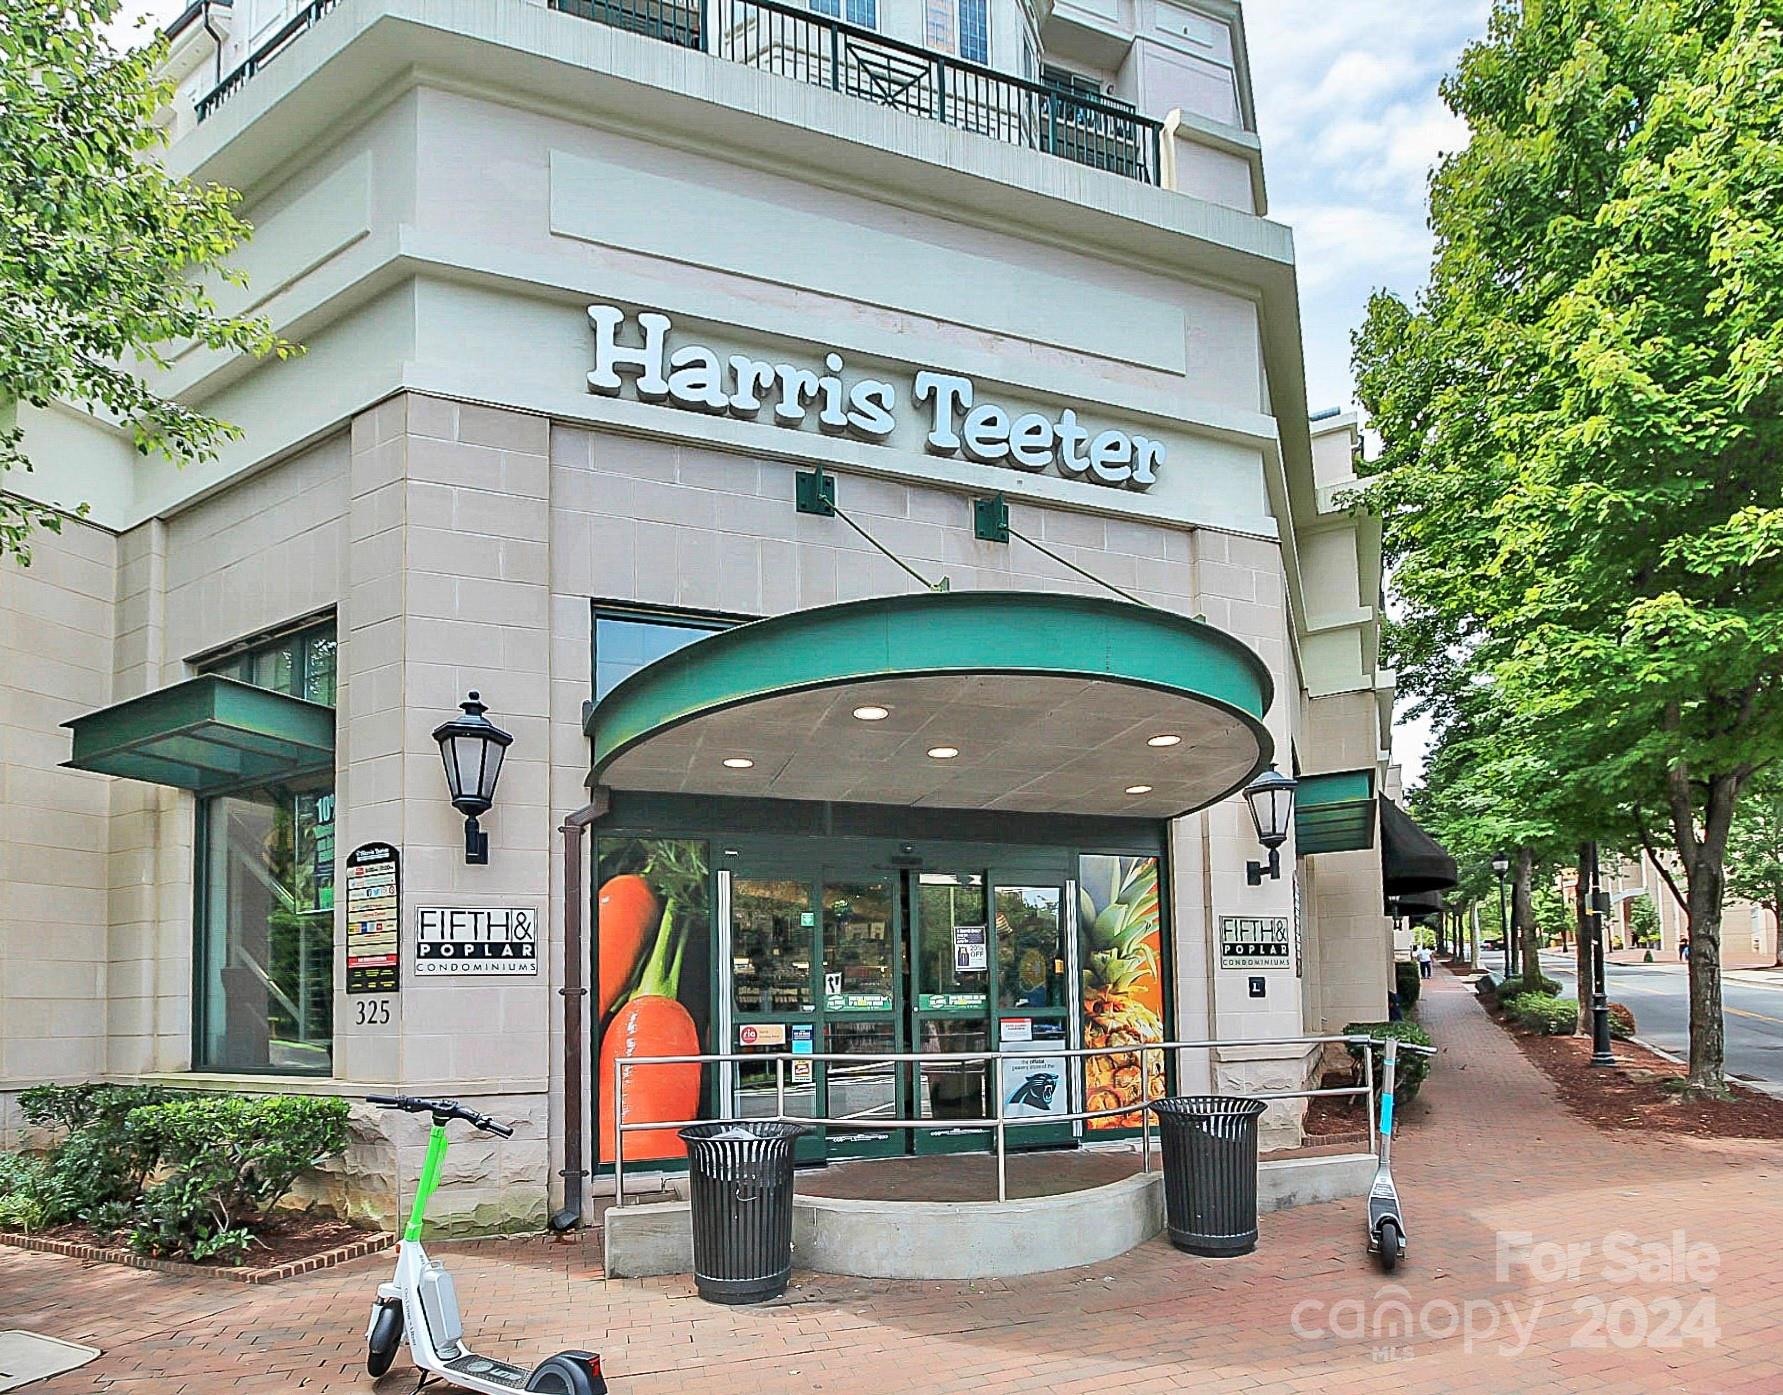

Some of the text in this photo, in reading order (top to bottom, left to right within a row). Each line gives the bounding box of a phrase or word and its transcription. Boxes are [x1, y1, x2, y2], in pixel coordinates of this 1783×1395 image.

[586, 304, 1165, 487] Harris Teeter
[420, 911, 509, 940] FIFTH
[1224, 919, 1273, 941] FIFTH
[420, 944, 533, 957] POPLAR
[1224, 945, 1287, 954] POPLAR
[416, 963, 536, 972] CONDOMINIUMS
[355, 1000, 390, 1025] 325
